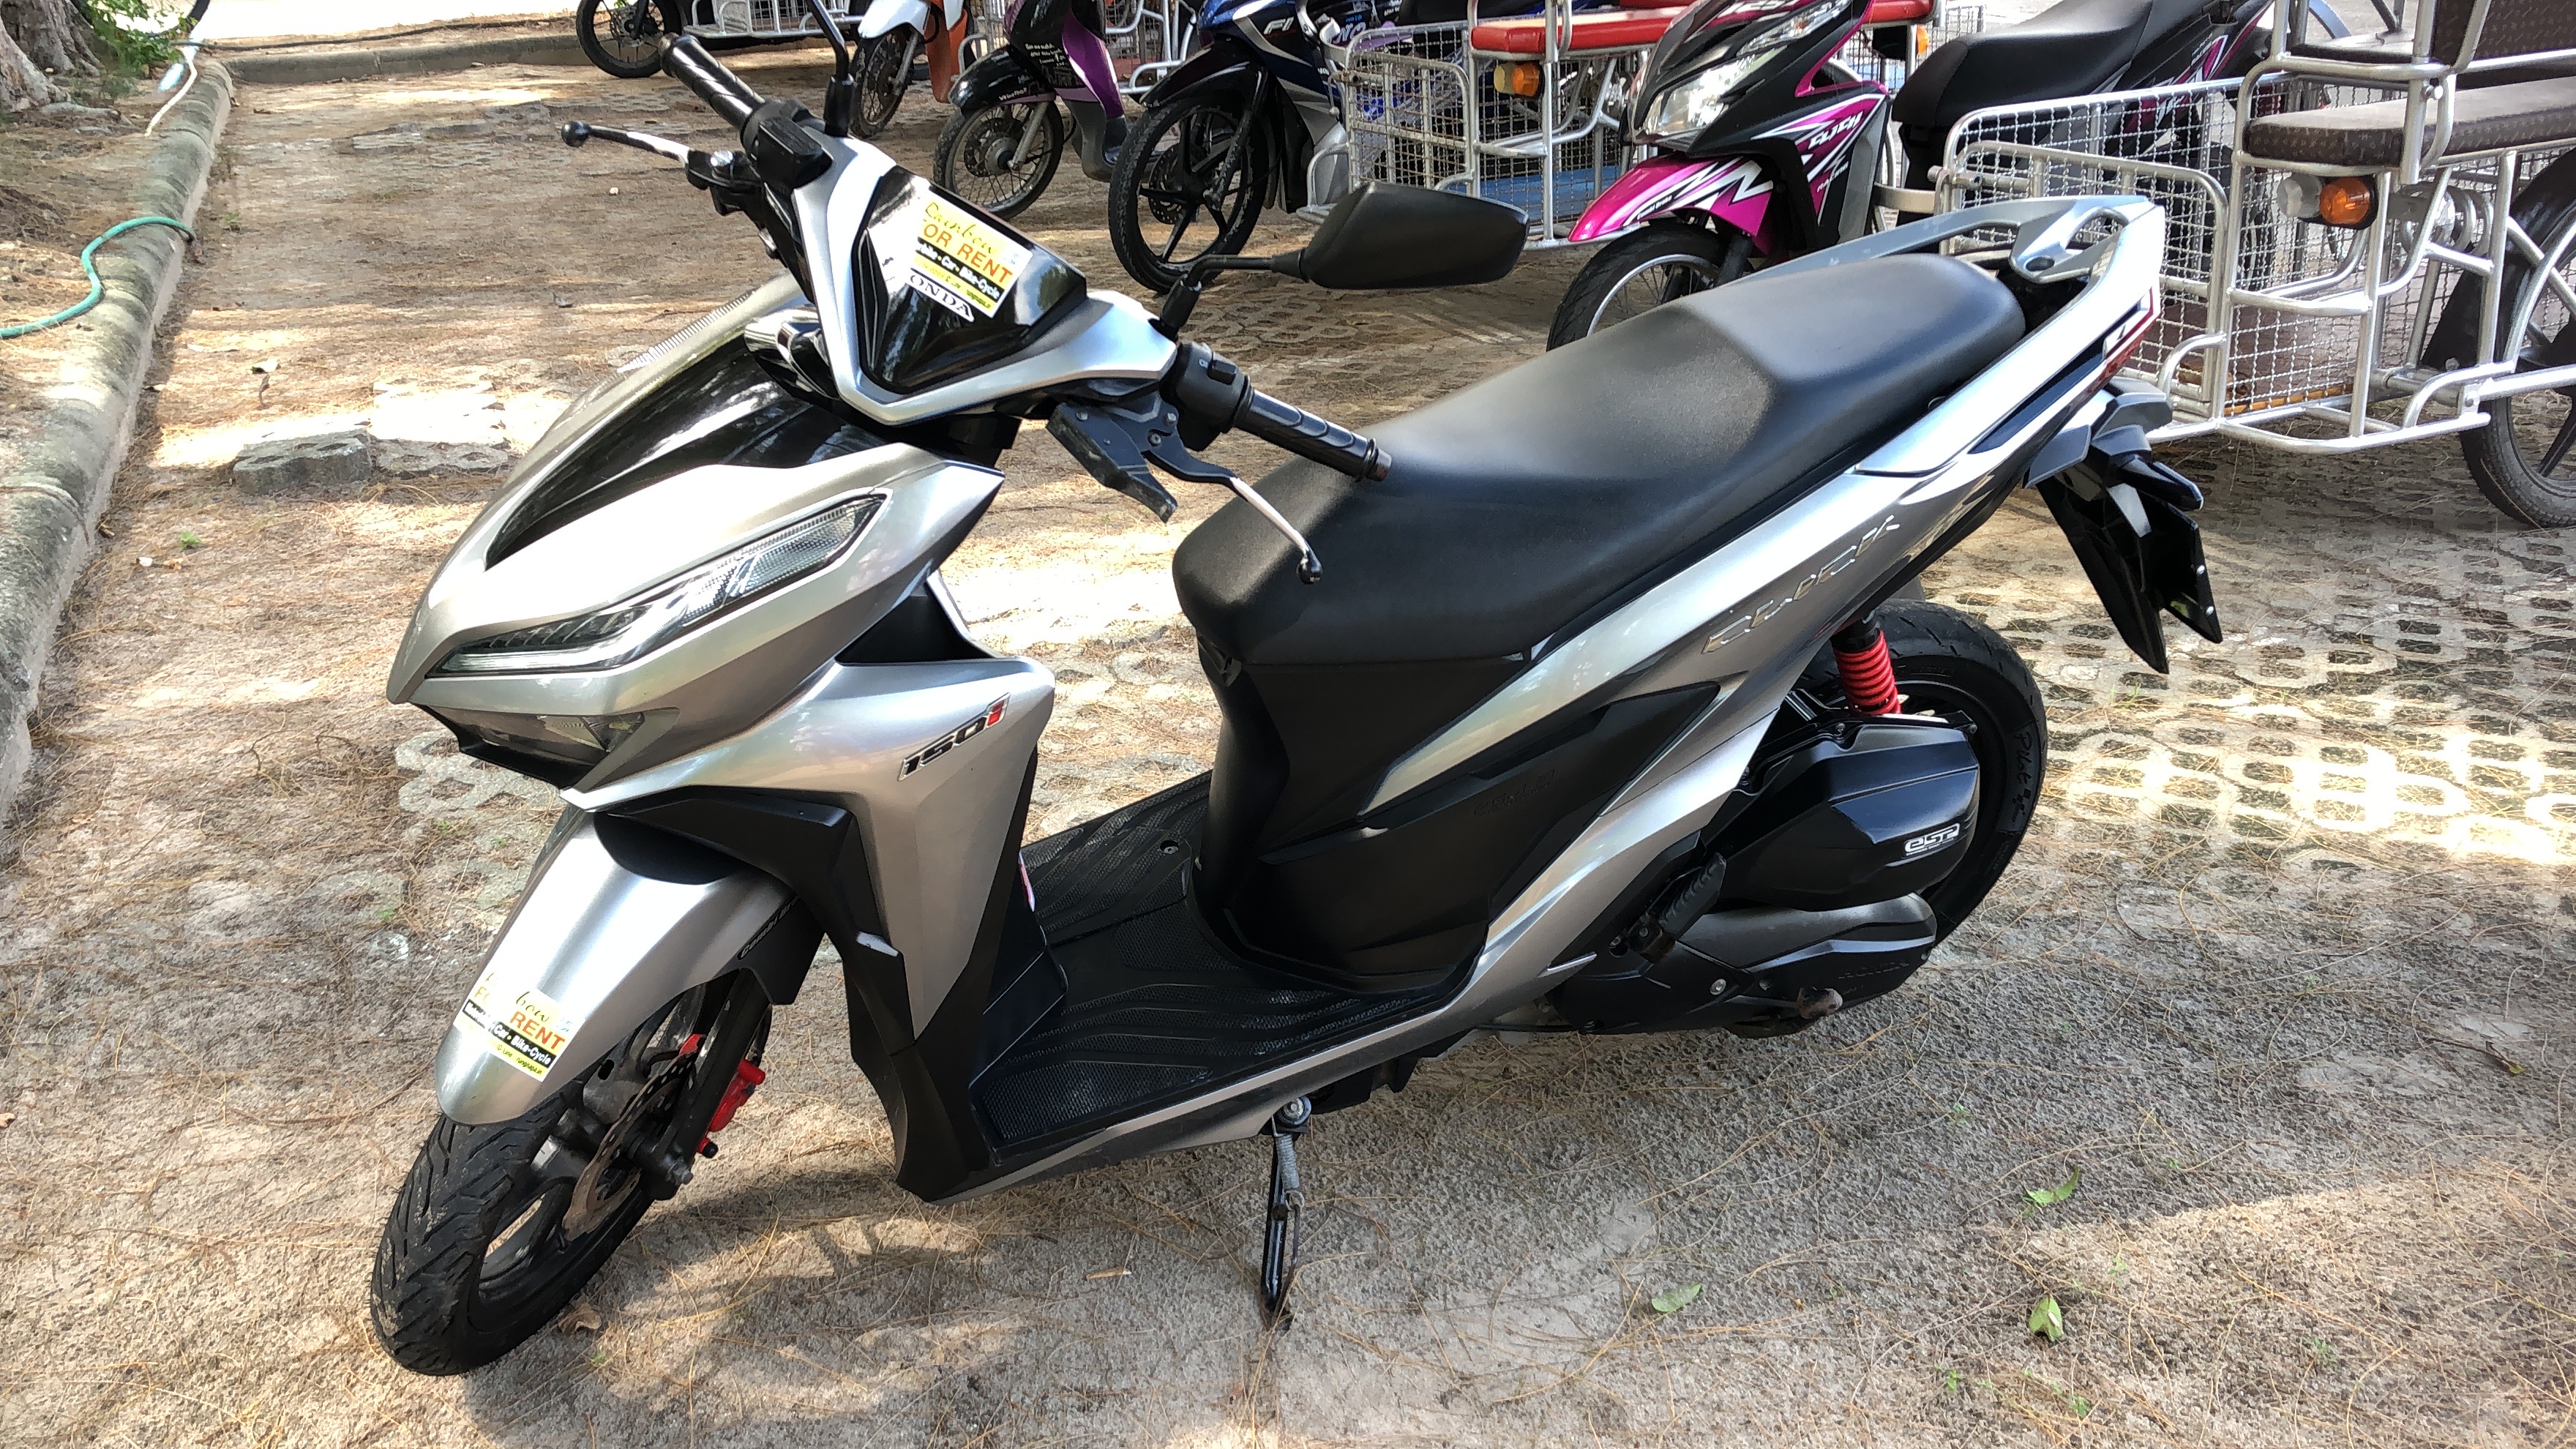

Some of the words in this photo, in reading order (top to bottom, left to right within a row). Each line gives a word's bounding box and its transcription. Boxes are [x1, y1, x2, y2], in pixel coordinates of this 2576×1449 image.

[1263, 16, 1295, 35] FI
[921, 218, 952, 247] OR
[957, 243, 1014, 284] RENT
[509, 1011, 566, 1050] RENT
